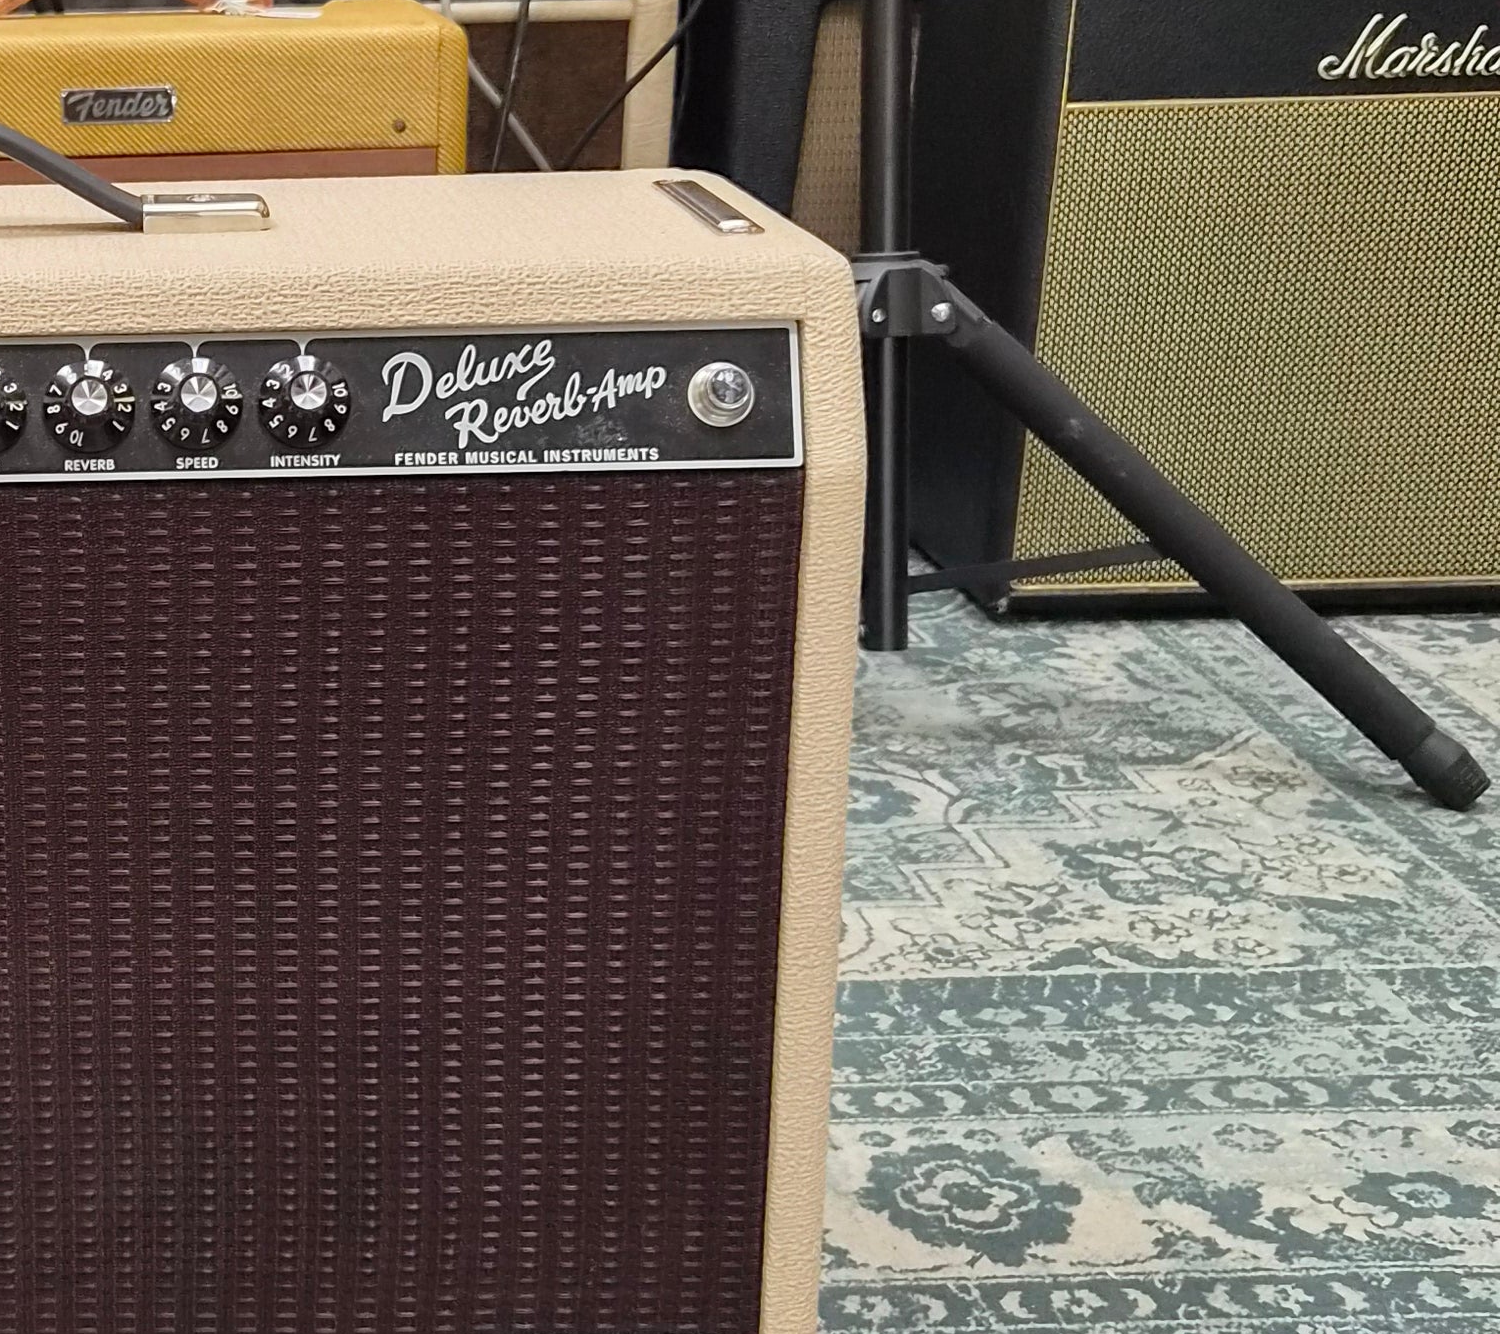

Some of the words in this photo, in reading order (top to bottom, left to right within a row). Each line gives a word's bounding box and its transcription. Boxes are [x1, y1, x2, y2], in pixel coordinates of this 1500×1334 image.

[67, 92, 170, 121] Fender
[3, 382, 18, 394] 3
[156, 382, 172, 393] 3
[265, 378, 280, 391] 3
[381, 339, 556, 423] Deluxe
[49, 384, 63, 396] 7
[113, 383, 128, 394] 3
[331, 381, 349, 398] 10
[46, 404, 60, 415] 8
[117, 403, 132, 413] 2
[262, 397, 277, 408] 4
[444, 366, 668, 450] Reverb-Amp
[161, 417, 177, 432] 5
[216, 419, 229, 434] 8
[268, 414, 284, 429] 5
[323, 418, 336, 432] 8
[201, 427, 211, 444] 7
[308, 426, 318, 442] 7
[176, 456, 219, 469] SPEED
[270, 453, 341, 467] INTENSITY
[394, 452, 459, 466] FENDER
[465, 450, 538, 464] MUSICAL
[543, 447, 660, 463] INSTRUMENTS
[64, 458, 116, 471] REVERB
